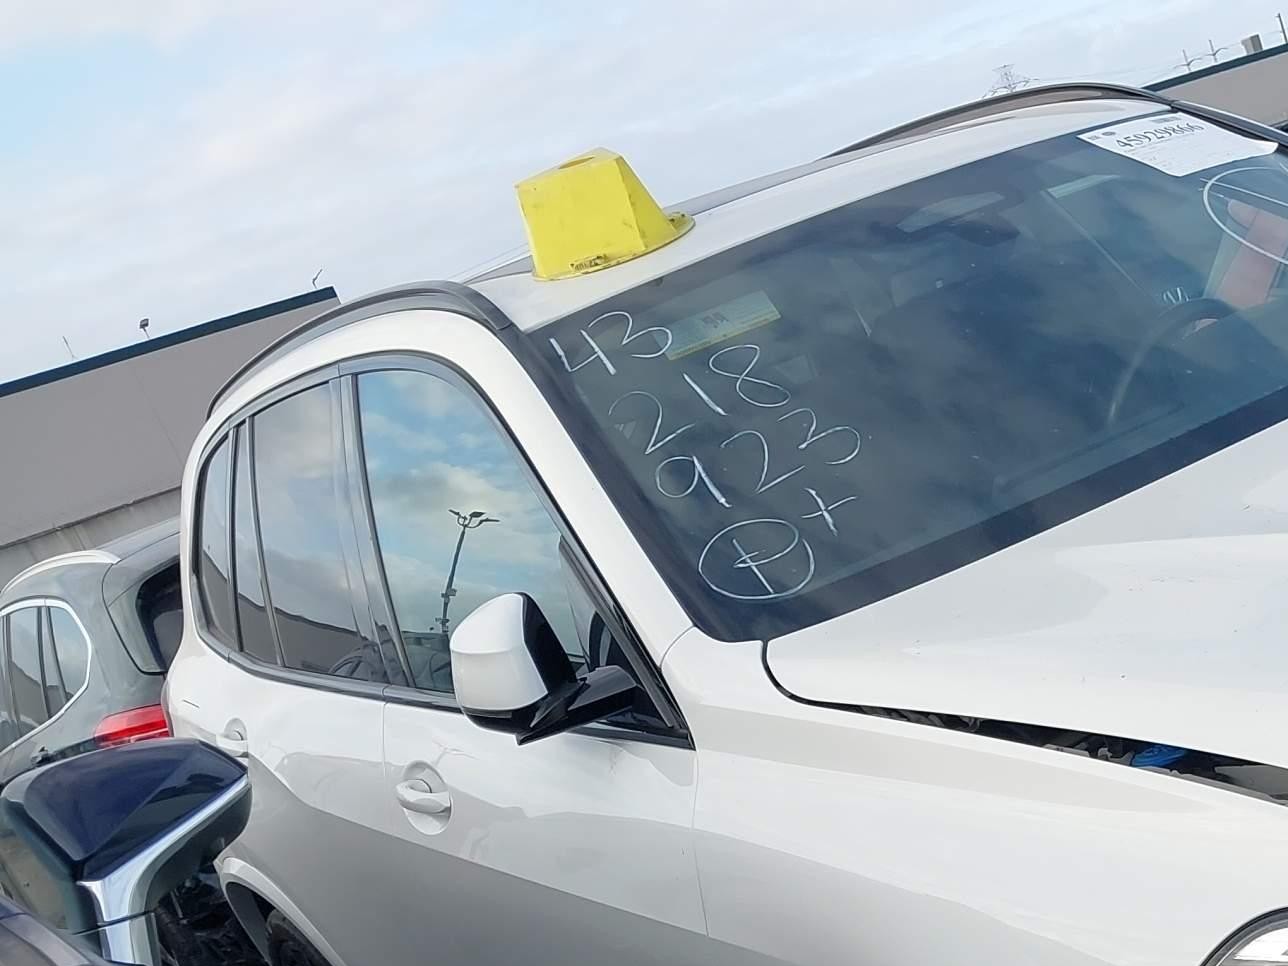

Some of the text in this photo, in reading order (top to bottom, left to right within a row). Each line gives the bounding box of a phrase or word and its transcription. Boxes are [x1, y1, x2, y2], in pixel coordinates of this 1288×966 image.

[1115, 122, 1205, 149] 45929866
[549, 311, 673, 375] 43
[608, 343, 792, 455] 218
[654, 407, 862, 508] 923
